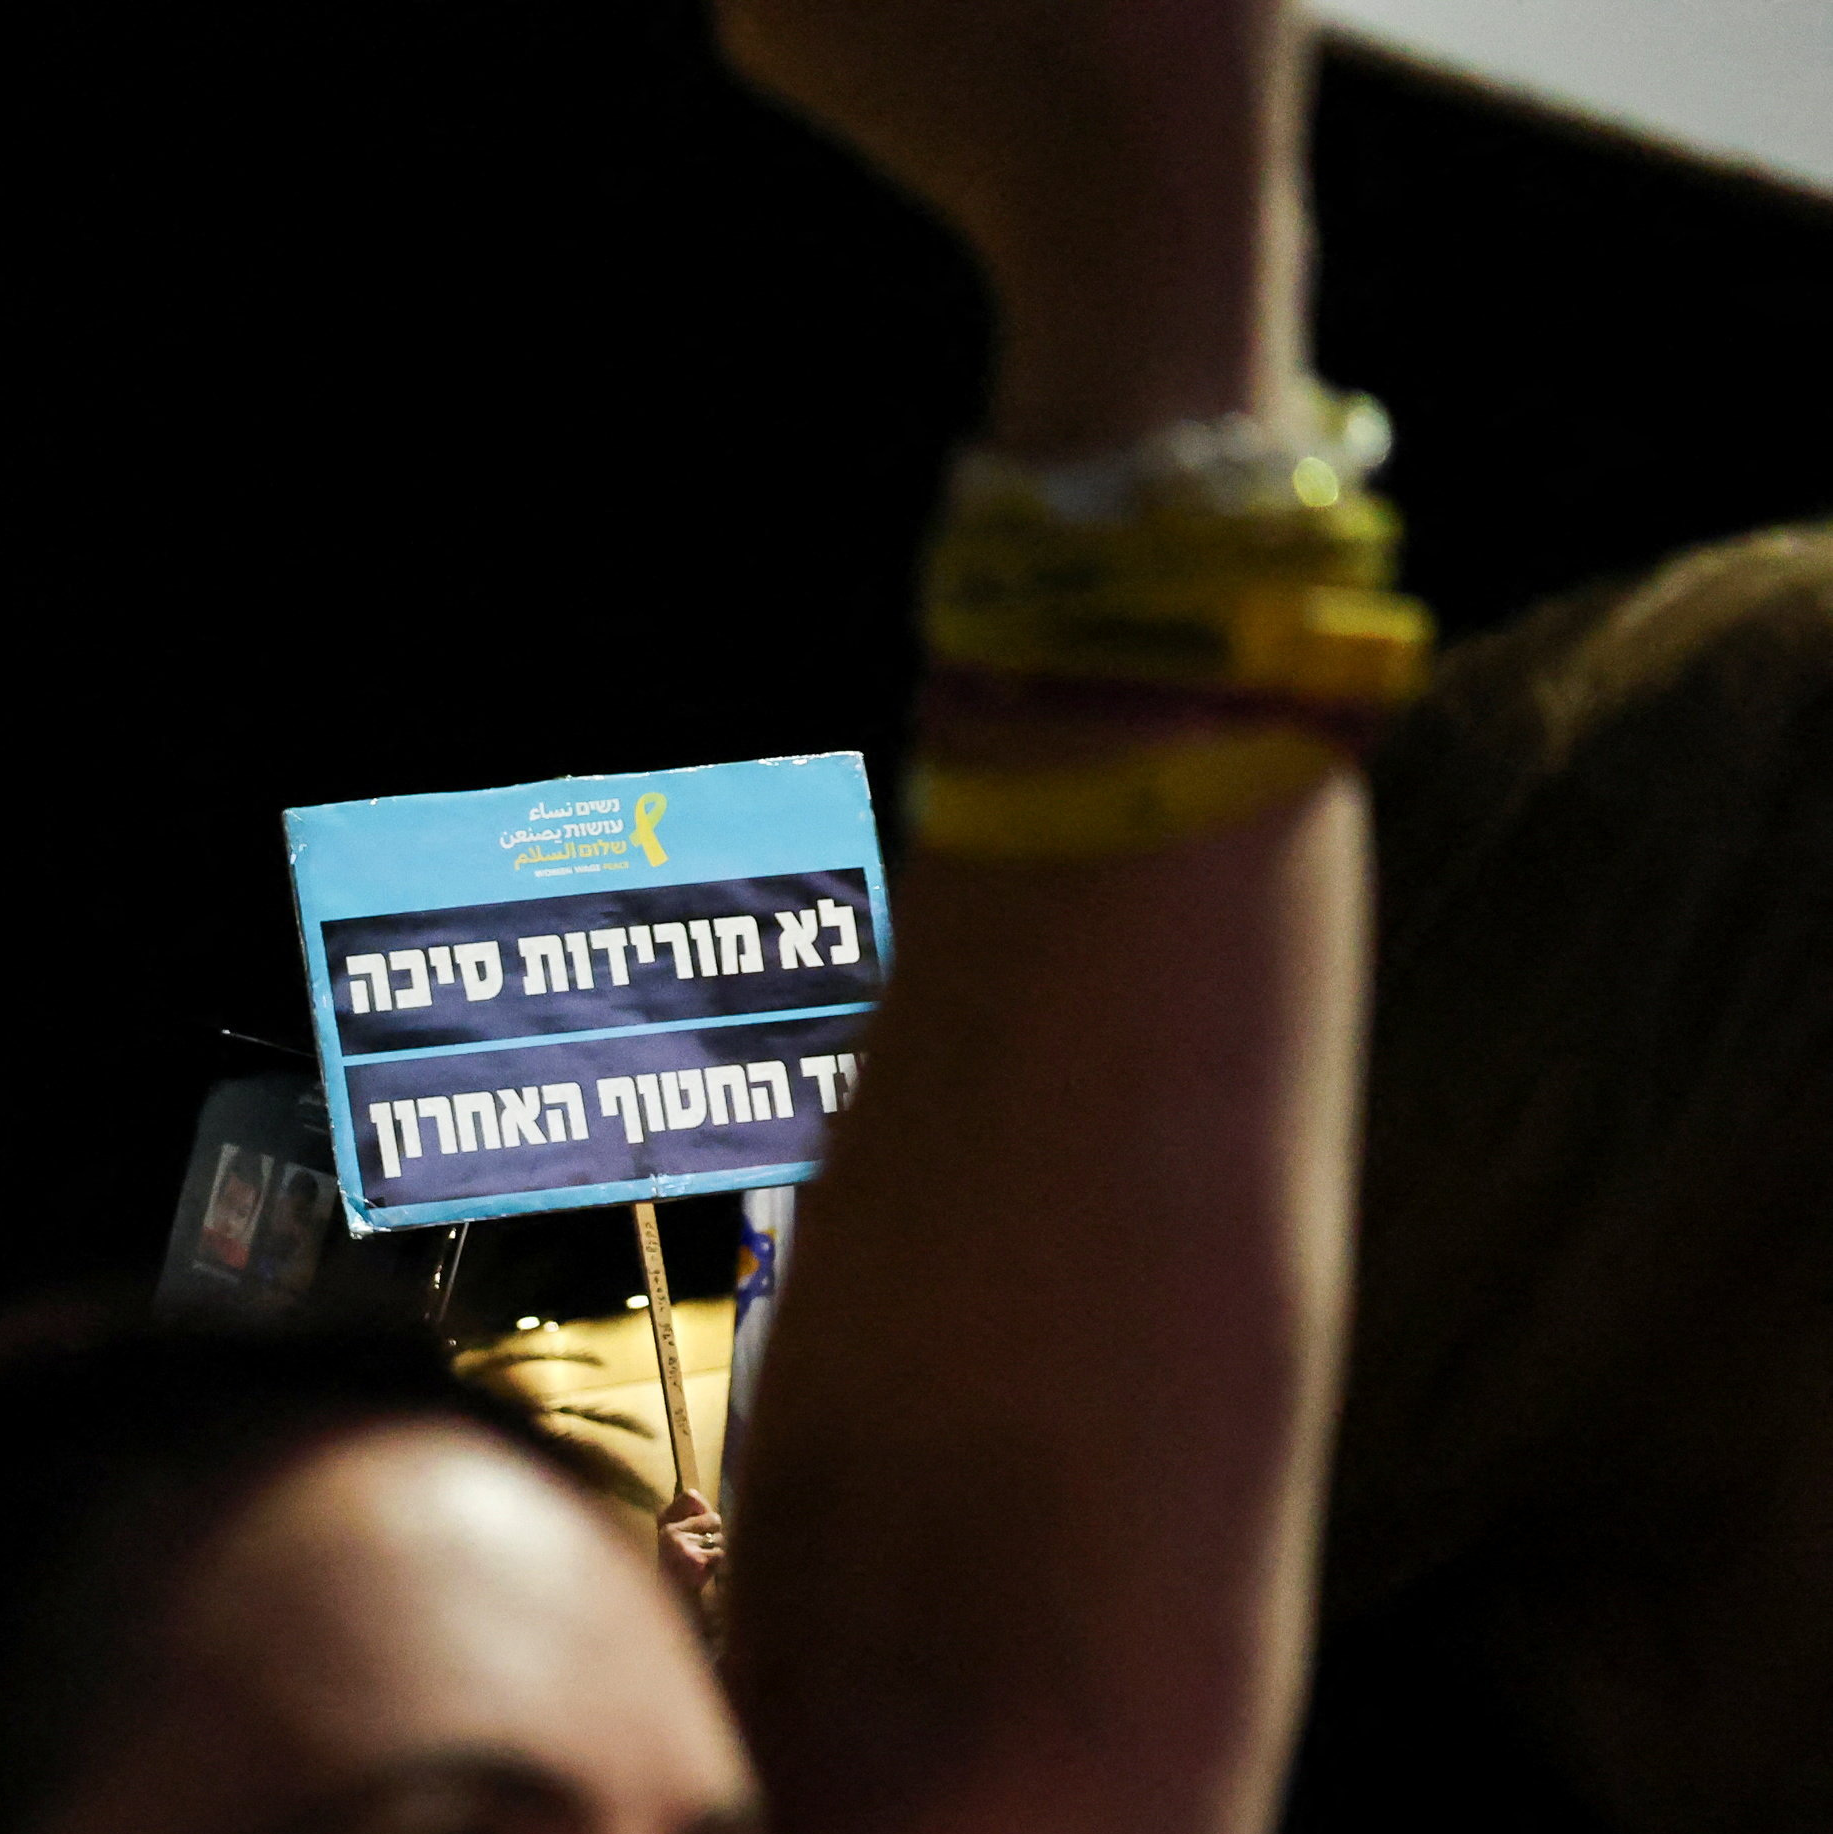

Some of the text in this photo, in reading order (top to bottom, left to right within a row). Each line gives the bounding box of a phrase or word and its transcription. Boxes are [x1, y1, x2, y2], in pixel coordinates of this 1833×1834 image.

[529, 801, 574, 822] نساء
[575, 797, 621, 817] נשים
[563, 818, 624, 839] עושות
[514, 841, 577, 870] السلام
[579, 839, 627, 858] שלום
[345, 898, 860, 1015] לא מורידות סיכה
[596, 1060, 795, 1145] החטוף
[368, 1081, 590, 1179] האחרון
